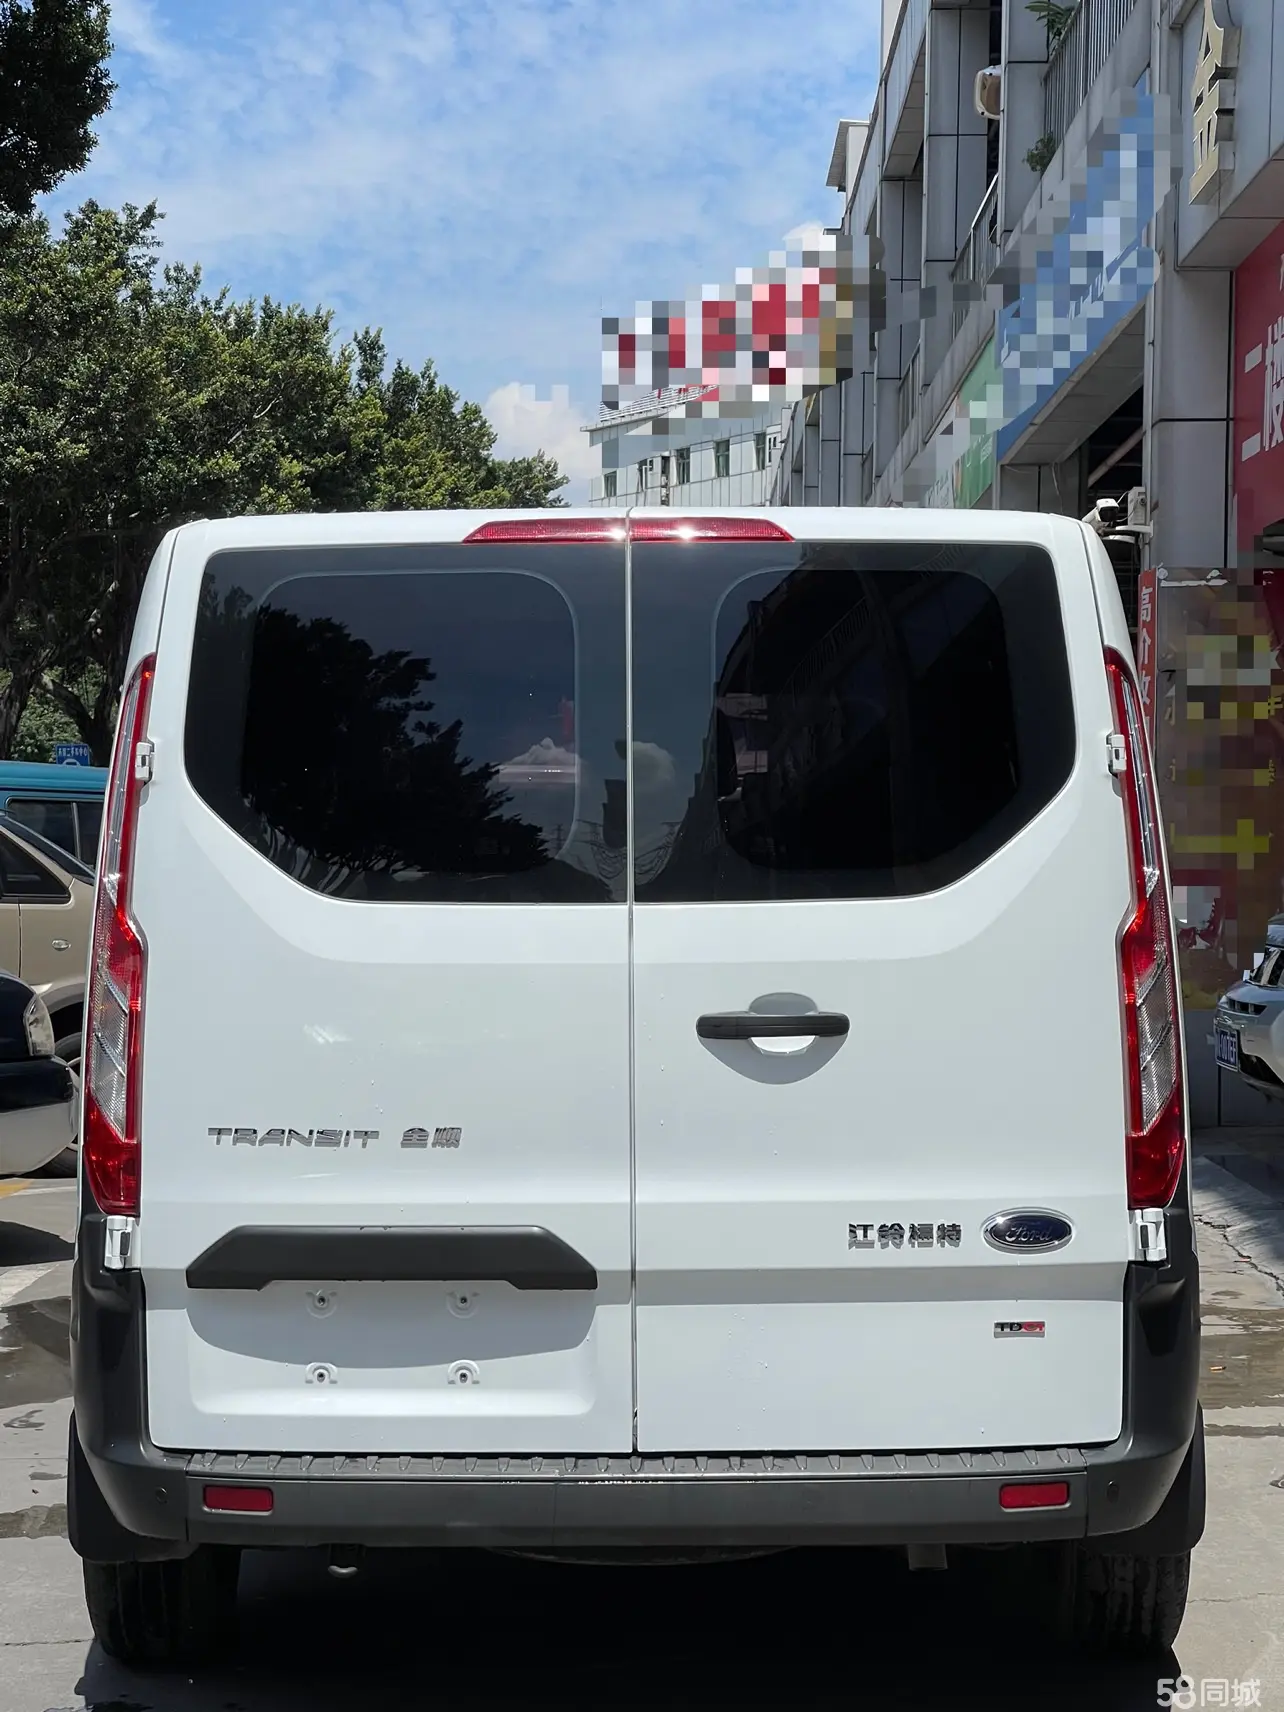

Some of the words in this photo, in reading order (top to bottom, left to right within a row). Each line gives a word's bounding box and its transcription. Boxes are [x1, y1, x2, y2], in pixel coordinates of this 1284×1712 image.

[207, 1127, 380, 1149] TRANSIT
[848, 1222, 963, 1250] 江铃福特
